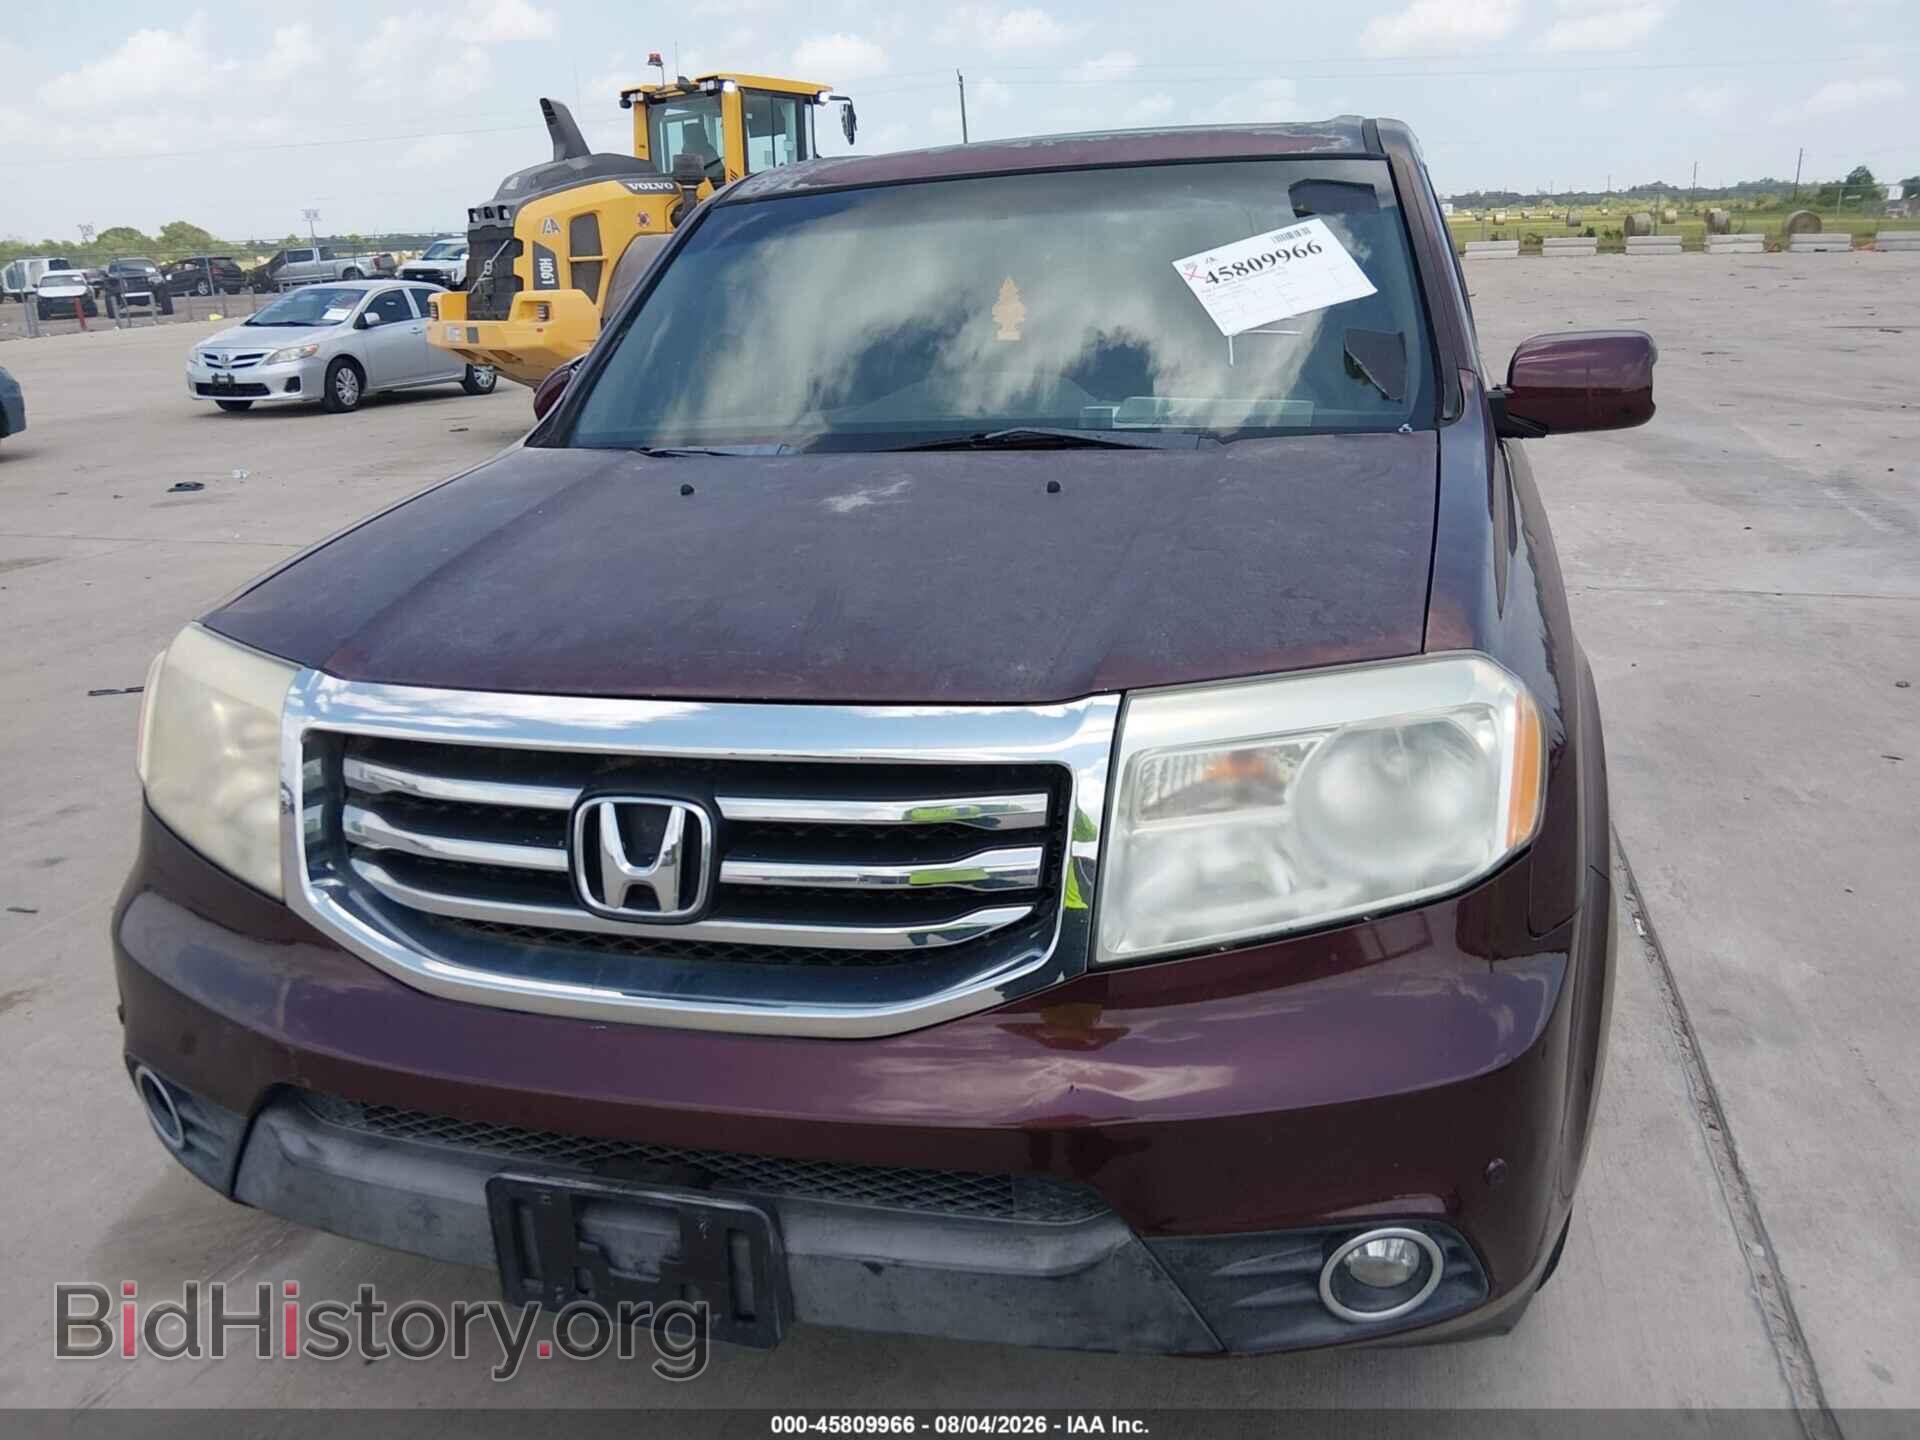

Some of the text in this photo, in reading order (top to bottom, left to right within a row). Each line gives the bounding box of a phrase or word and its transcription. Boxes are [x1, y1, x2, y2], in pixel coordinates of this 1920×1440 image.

[627, 182, 674, 191] VOLVO
[538, 258, 555, 285] L90H
[1204, 239, 1323, 285] 45809966
